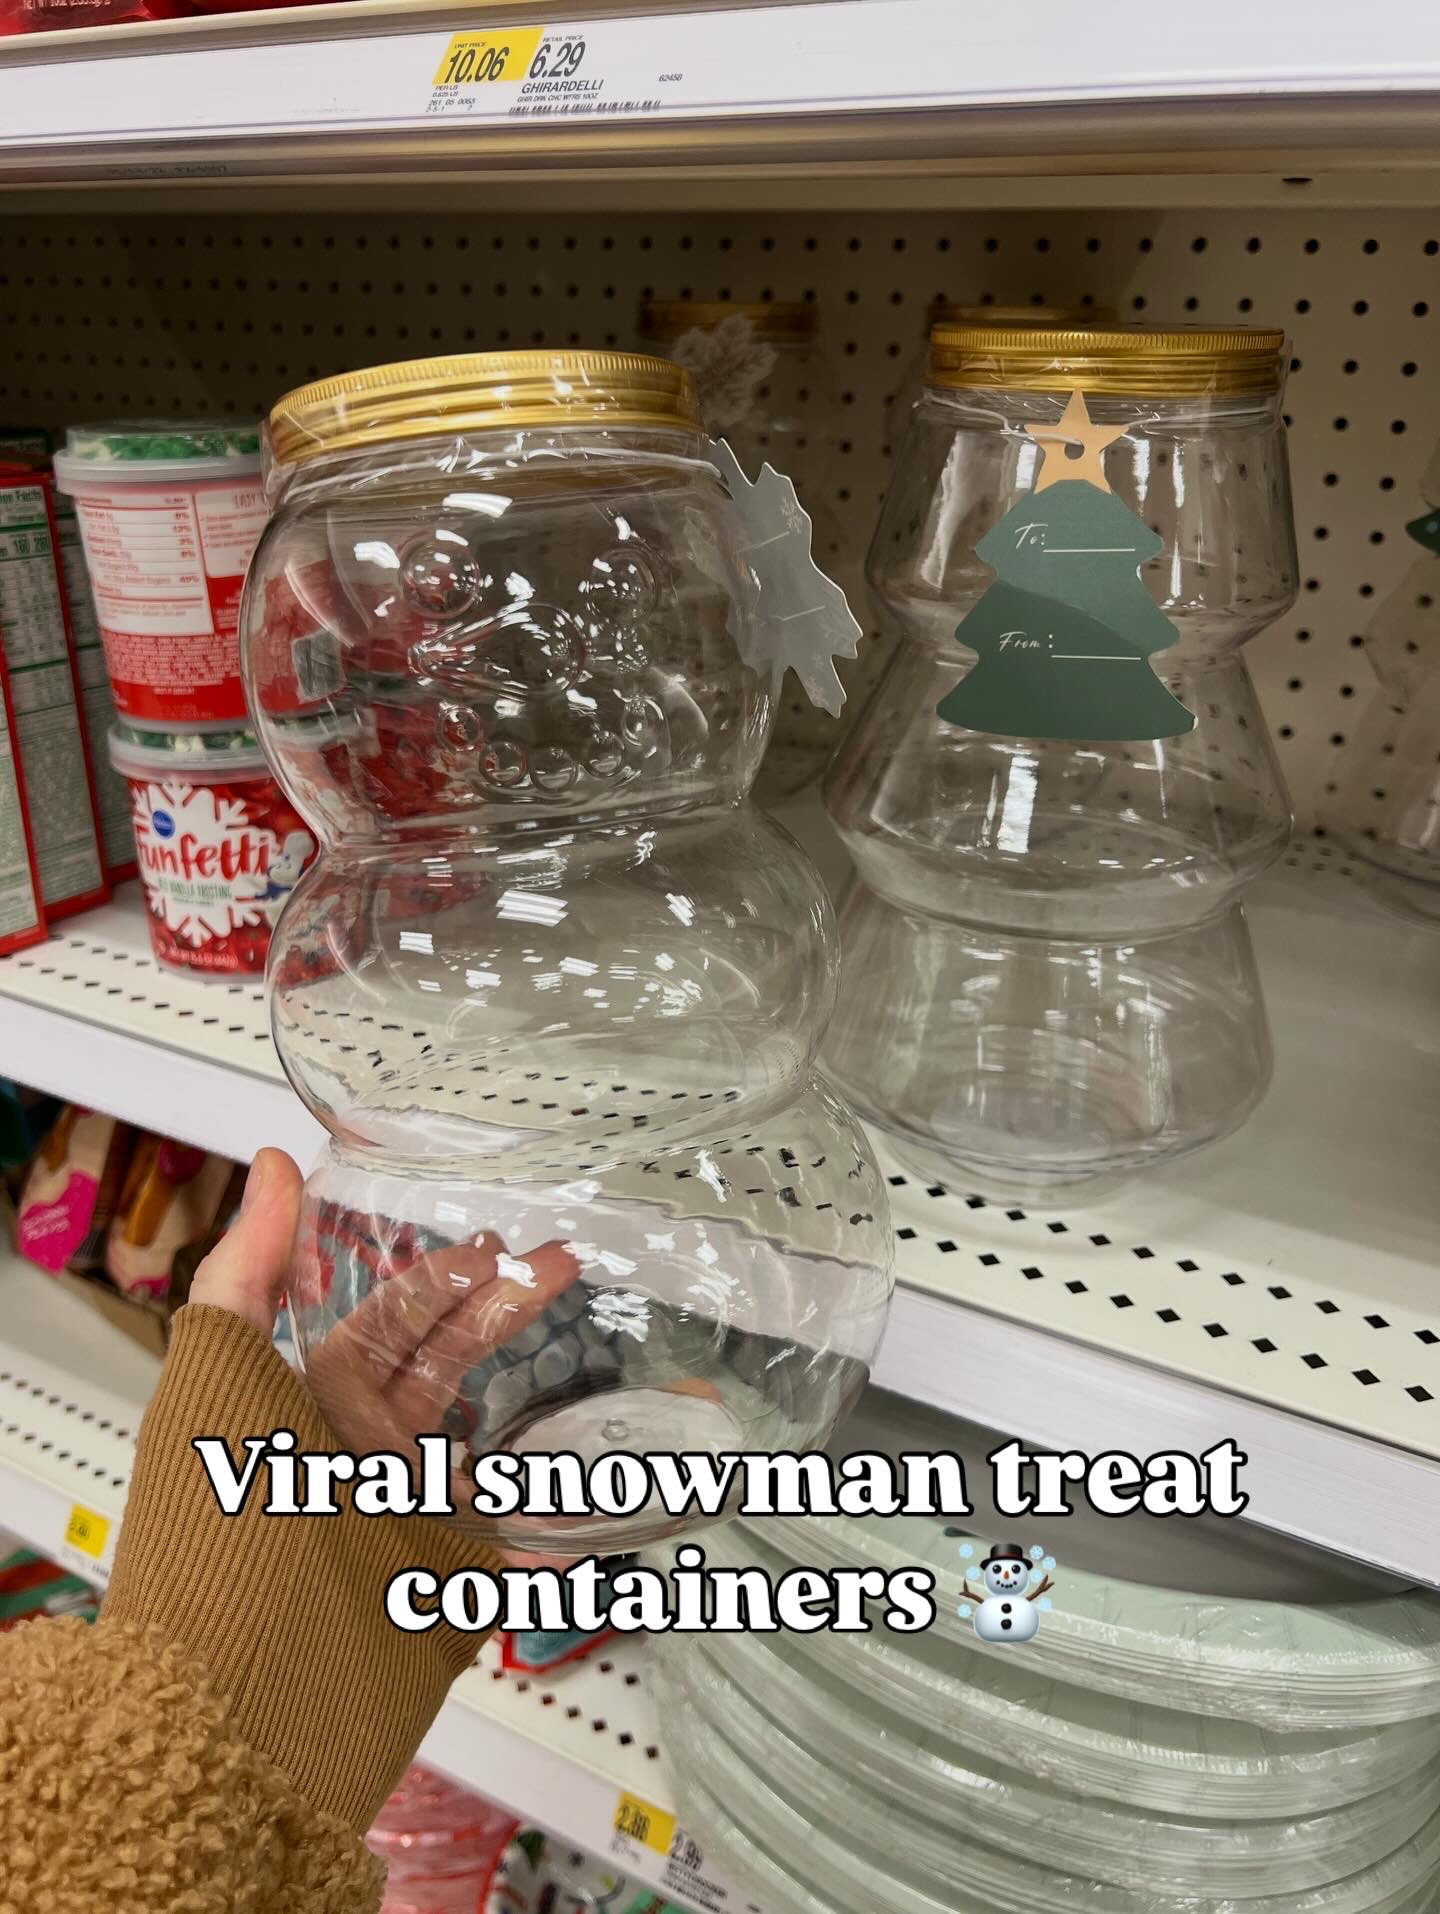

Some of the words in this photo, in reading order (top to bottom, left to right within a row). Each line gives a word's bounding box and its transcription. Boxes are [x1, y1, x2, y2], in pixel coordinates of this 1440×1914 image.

[444, 46, 510, 84] 10.06
[529, 41, 586, 79] 6.29
[521, 79, 604, 94] GHIRARDELLI
[1013, 522, 1049, 549] To:
